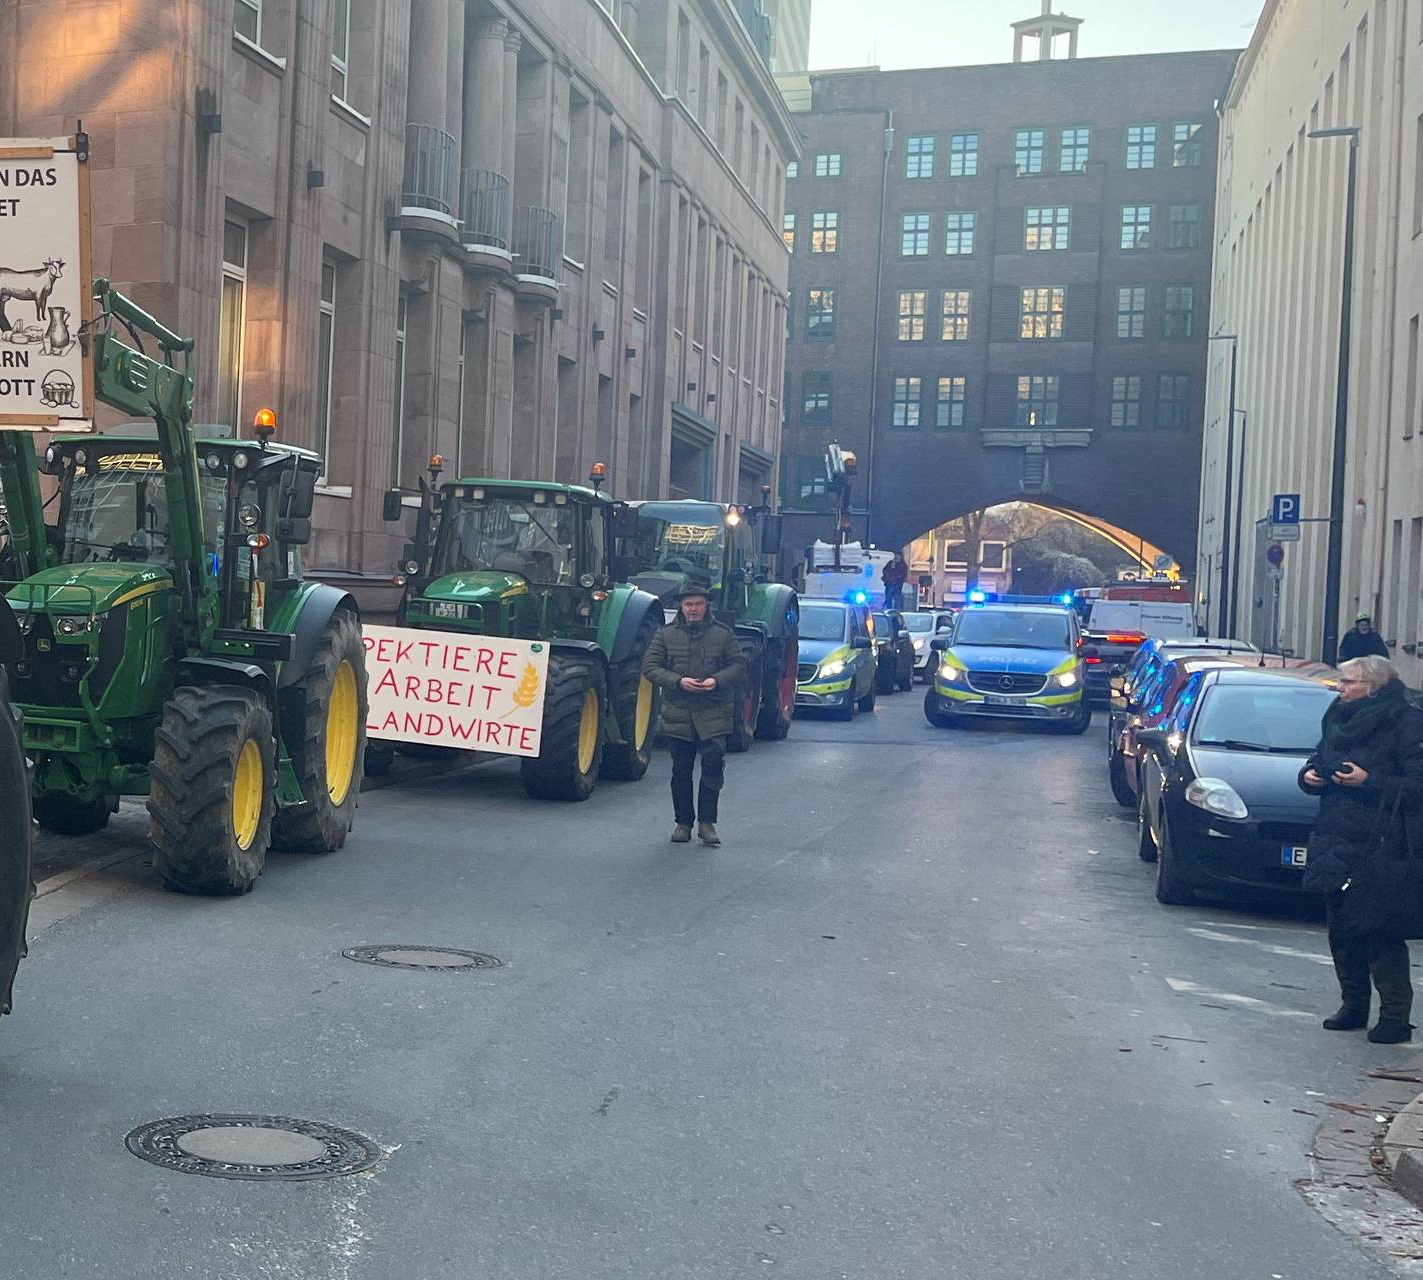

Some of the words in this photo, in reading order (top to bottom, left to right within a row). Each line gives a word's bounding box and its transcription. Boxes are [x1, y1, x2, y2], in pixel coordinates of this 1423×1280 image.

[15, 168, 57, 187] DAS
[1278, 497, 1294, 521] P
[374, 667, 502, 711] ARBEIT
